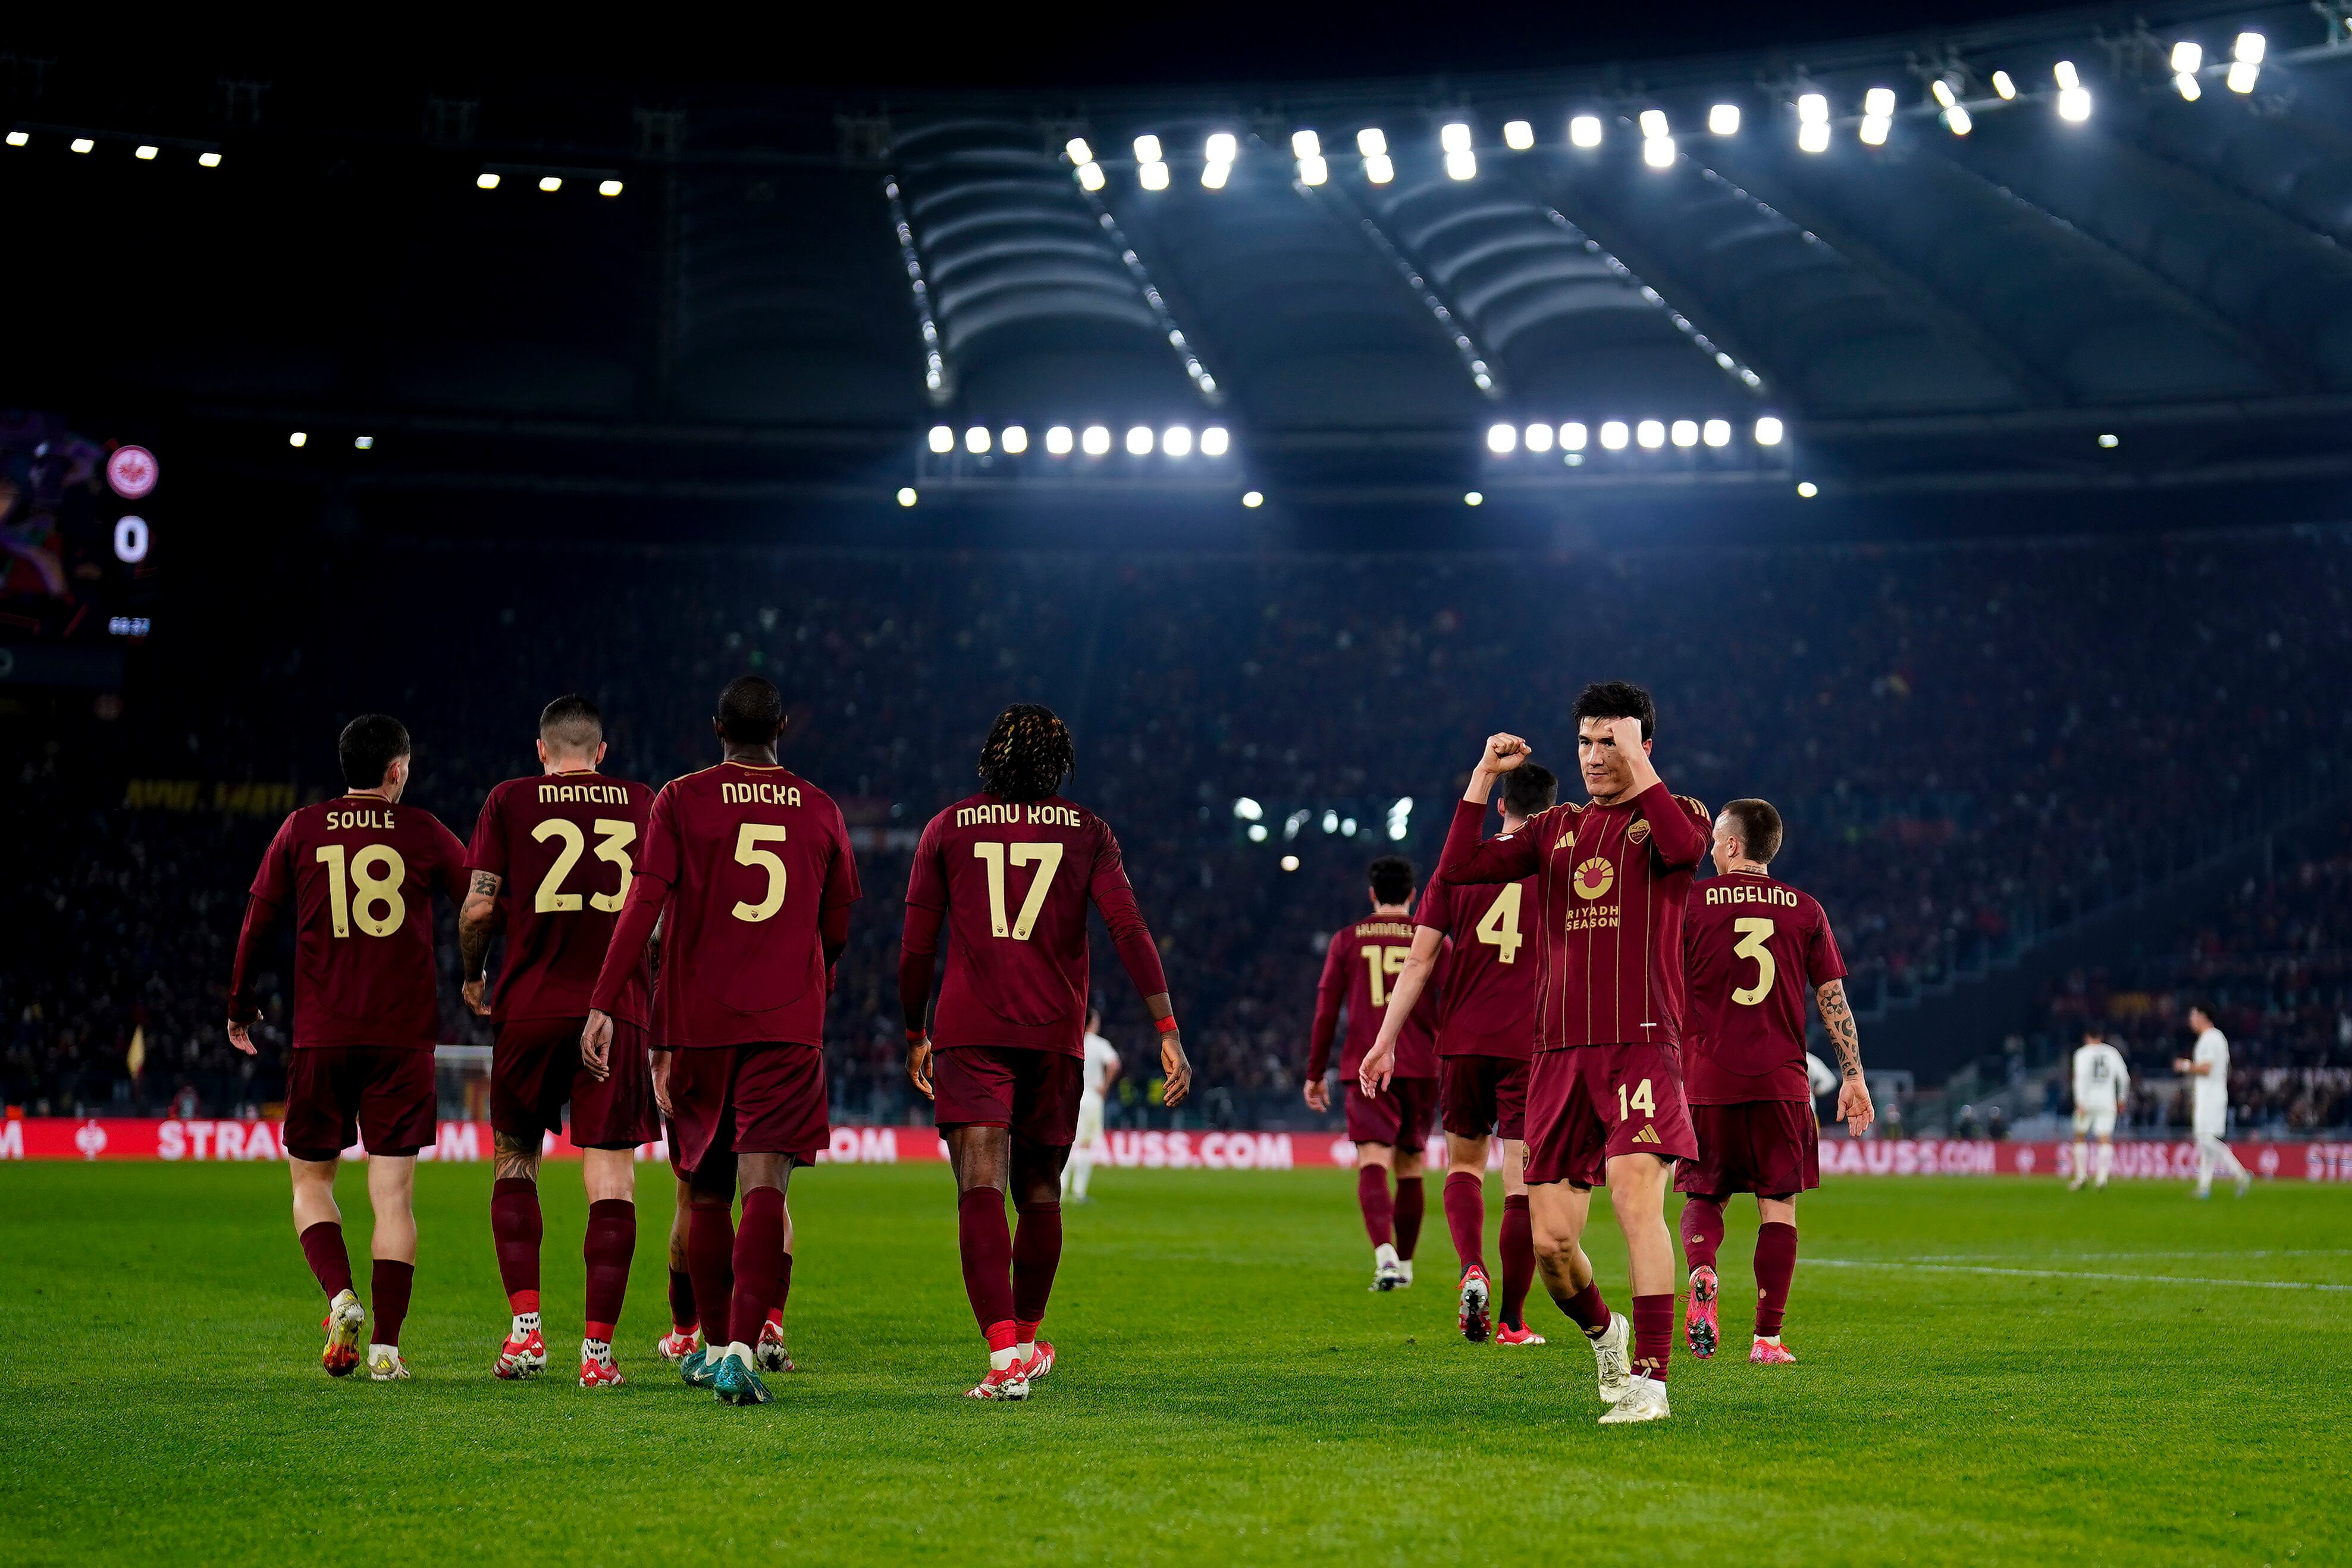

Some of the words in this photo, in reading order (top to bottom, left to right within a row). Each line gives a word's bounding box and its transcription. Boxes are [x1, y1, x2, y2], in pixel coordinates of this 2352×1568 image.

[114, 515, 149, 563] 0
[538, 785, 629, 805] MANCINI
[722, 783, 801, 808] NDICKA
[327, 810, 396, 831] SOULÉ
[957, 804, 1020, 827] MANU
[1027, 805, 1081, 827] KONE
[531, 818, 637, 914] 23
[732, 823, 787, 923] 5
[316, 844, 406, 938] 18
[974, 842, 1064, 941] 17
[1705, 885, 1798, 908] ANGELIÑO
[1476, 882, 1523, 964] 4
[1566, 917, 1618, 932] SEASON
[1567, 905, 1619, 920] RIYADH
[1355, 923, 1417, 938] HUMMEL
[1731, 917, 1776, 1006] 3
[1618, 1078, 1656, 1121] 14
